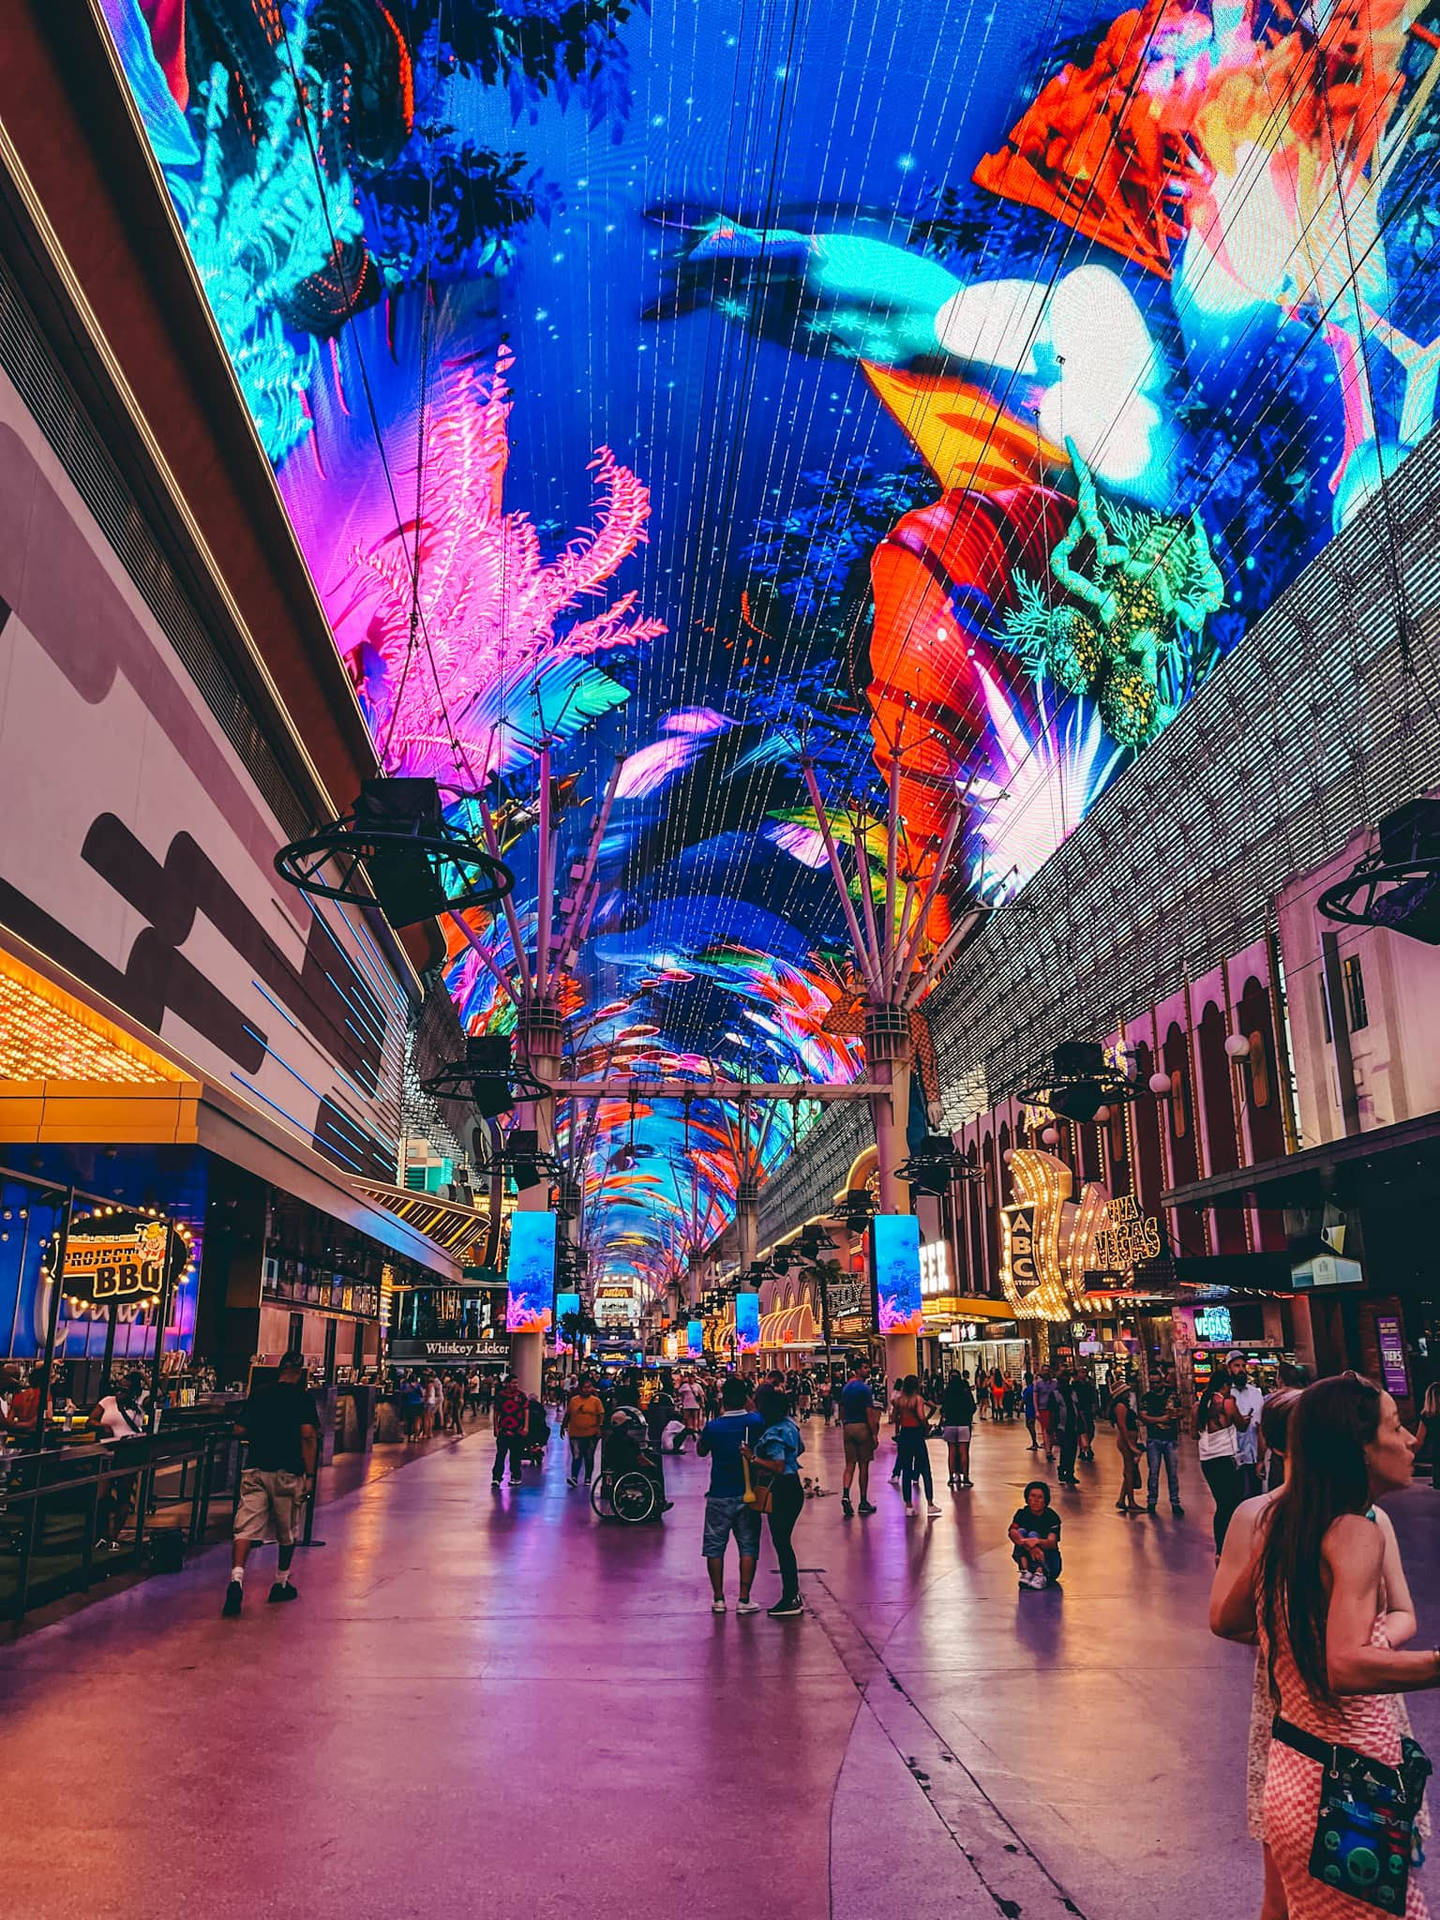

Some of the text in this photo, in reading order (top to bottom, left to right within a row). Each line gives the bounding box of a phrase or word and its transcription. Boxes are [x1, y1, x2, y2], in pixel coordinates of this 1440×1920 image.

[1106, 1195, 1138, 1222] VIVA
[1012, 1213, 1034, 1277] ABC
[1095, 1217, 1160, 1265] VEGAS
[96, 1261, 159, 1293] BBQ
[1195, 1316, 1230, 1336] VEGAS
[426, 1342, 509, 1356] Whiskey Licker
